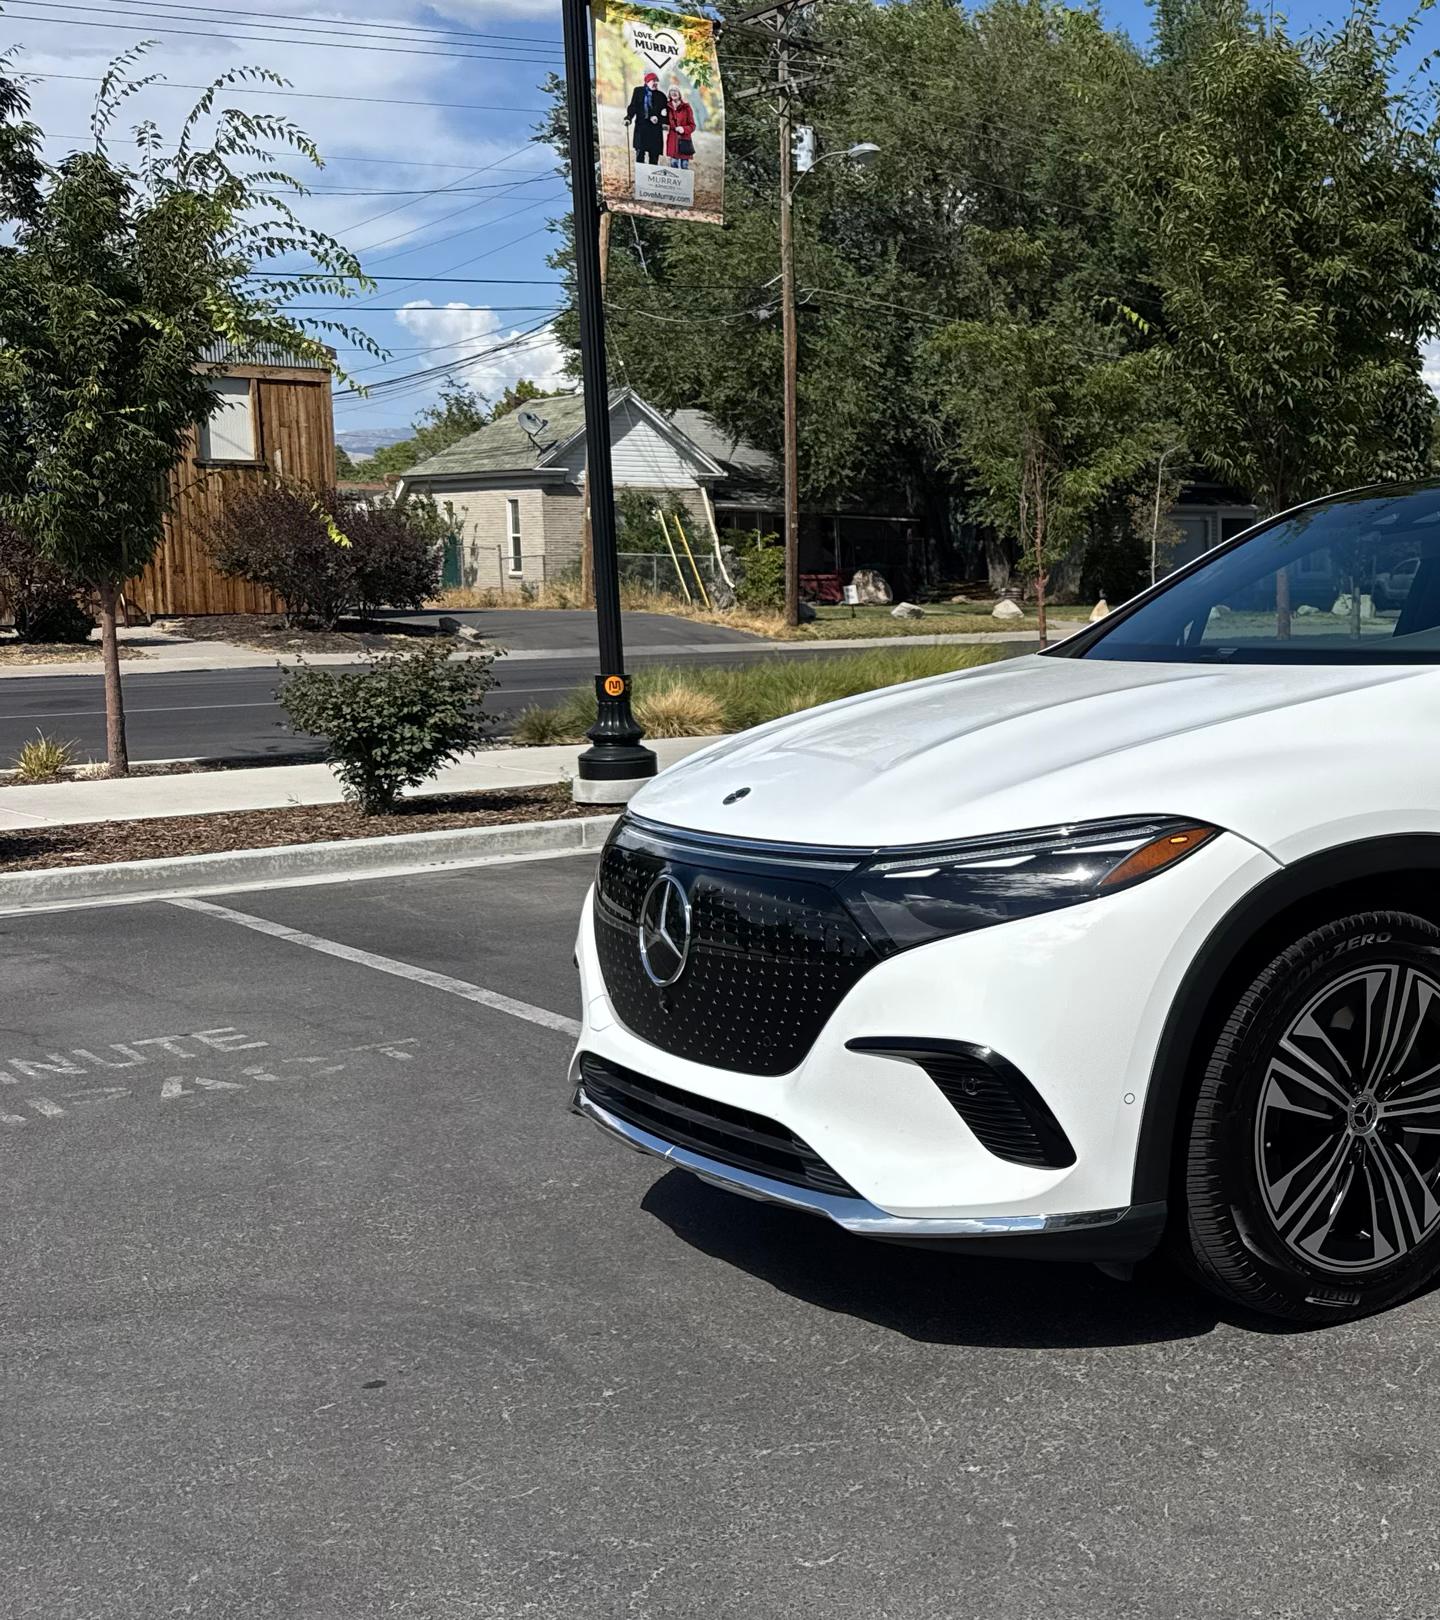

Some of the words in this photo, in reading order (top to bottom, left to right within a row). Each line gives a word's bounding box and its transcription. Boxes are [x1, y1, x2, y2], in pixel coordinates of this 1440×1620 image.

[635, 39, 679, 55] MURRAY
[648, 175, 682, 186] MURRAY
[639, 190, 691, 203] LoveMurray.com
[1332, 931, 1393, 955] ZERO
